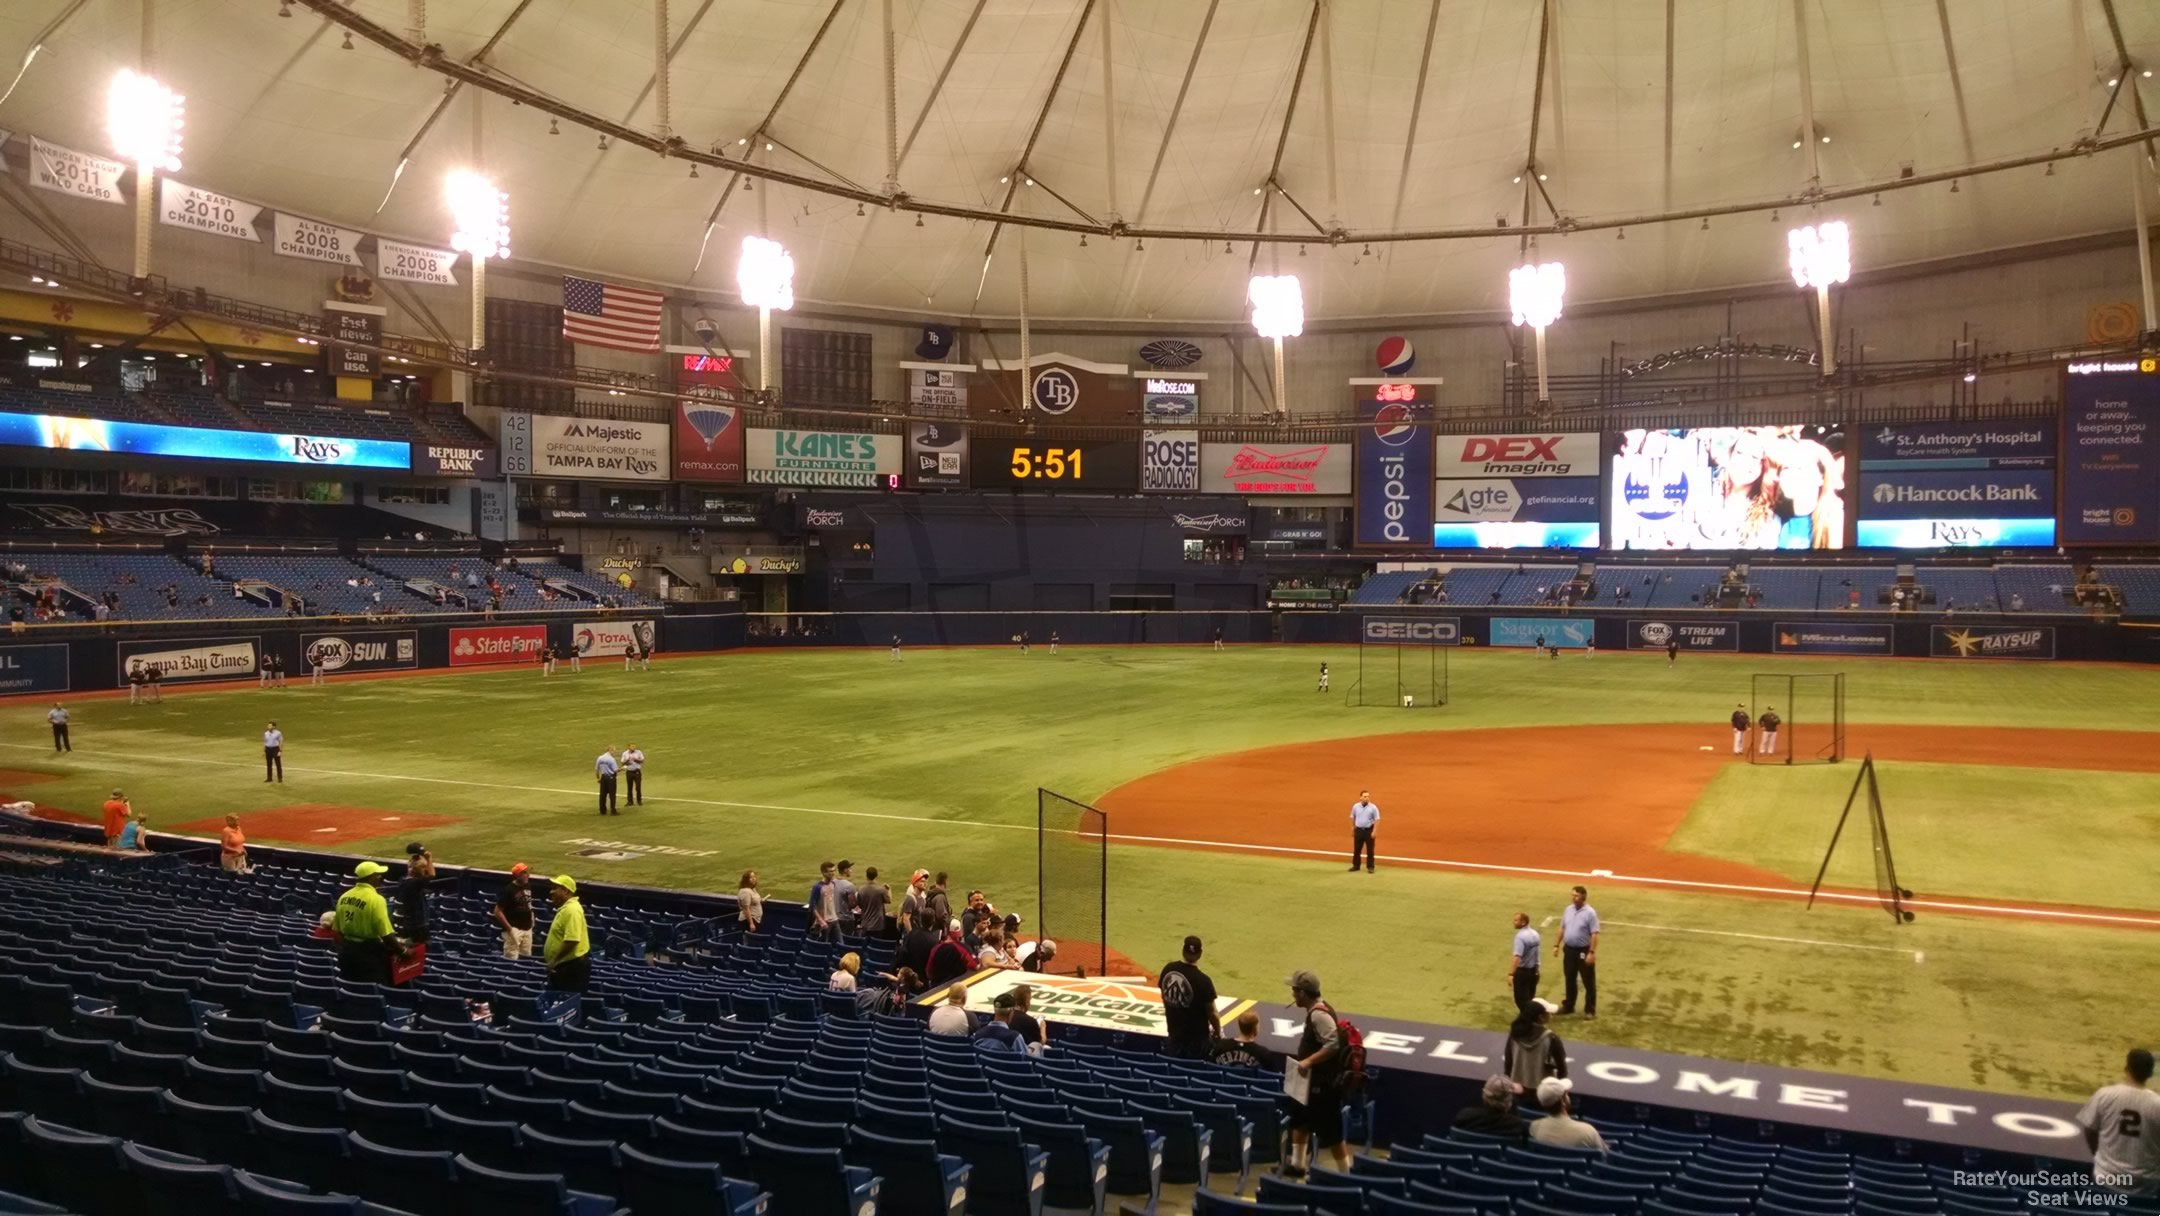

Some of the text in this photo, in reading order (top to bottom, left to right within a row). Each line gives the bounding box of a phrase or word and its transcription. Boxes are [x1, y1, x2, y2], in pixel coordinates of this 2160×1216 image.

[55, 160, 99, 186] 2011
[41, 171, 111, 200] WILD CARD
[189, 190, 232, 207] AL EAST
[184, 199, 235, 223] 2010
[168, 210, 248, 237] CHAMPIONS
[298, 222, 337, 235] AL EAST
[295, 230, 340, 251] 2008
[281, 242, 351, 263] CHAMPIONS
[397, 254, 437, 272] 2008
[384, 266, 448, 283] CHAMPIONS
[928, 331, 940, 345] TB
[2068, 363, 2138, 375] bright house
[1042, 377, 1071, 406] TB
[921, 395, 957, 404] ON-FIELD
[2095, 400, 2128, 409] home
[507, 416, 526, 431] 42
[2077, 423, 2146, 433] keeping you
[586, 424, 642, 441] Majestic
[1897, 431, 2041, 447] St. Anthony's Hospital
[2080, 434, 2143, 445] connected.
[509, 437, 523, 450] 12
[546, 443, 657, 457] OFFICIAL UNIFORM OF THE
[775, 431, 876, 459] KANE'S
[1461, 437, 1565, 462] DEX
[428, 447, 484, 460] REPUBLIC
[1144, 440, 1197, 467] ROSE
[1952, 448, 1977, 456] System
[440, 459, 473, 471] BANK
[507, 457, 526, 471] 66
[547, 455, 595, 468] TAMPA
[597, 457, 623, 469] BAY
[680, 460, 739, 471] remax.com
[779, 460, 871, 470] FURNITURE
[1011, 448, 1082, 479] 5:51
[1483, 462, 1571, 475] imaging
[1144, 467, 1197, 488] RADIOLOGY
[1380, 456, 1411, 541] pepsi
[1470, 486, 1508, 508] gte
[1897, 484, 2038, 501] Hancock Bank
[1526, 495, 1595, 507] gtefinancial.org
[1478, 505, 1513, 516] financial
[807, 516, 844, 526] PORCH
[1213, 518, 1246, 527] PORCH
[603, 557, 642, 570] Ducky's
[761, 558, 799, 573] Ducky's
[1367, 622, 1456, 639] GEICO
[1500, 621, 1558, 638] Sagicor
[1648, 626, 1665, 634] FOX
[1680, 627, 1725, 635] STREAM
[598, 633, 634, 643] TOTAL
[1691, 637, 1714, 645] LIVE
[1802, 634, 1885, 642] MicroLumen
[316, 643, 343, 657] FOX
[353, 643, 388, 661] SUN
[181, 655, 207, 673] Bay
[210, 652, 249, 667] Times
[1038, 1006, 1131, 1021] IELD
[1271, 1018, 2081, 1138] WELOME TO
[2120, 1109, 2141, 1137] 2
